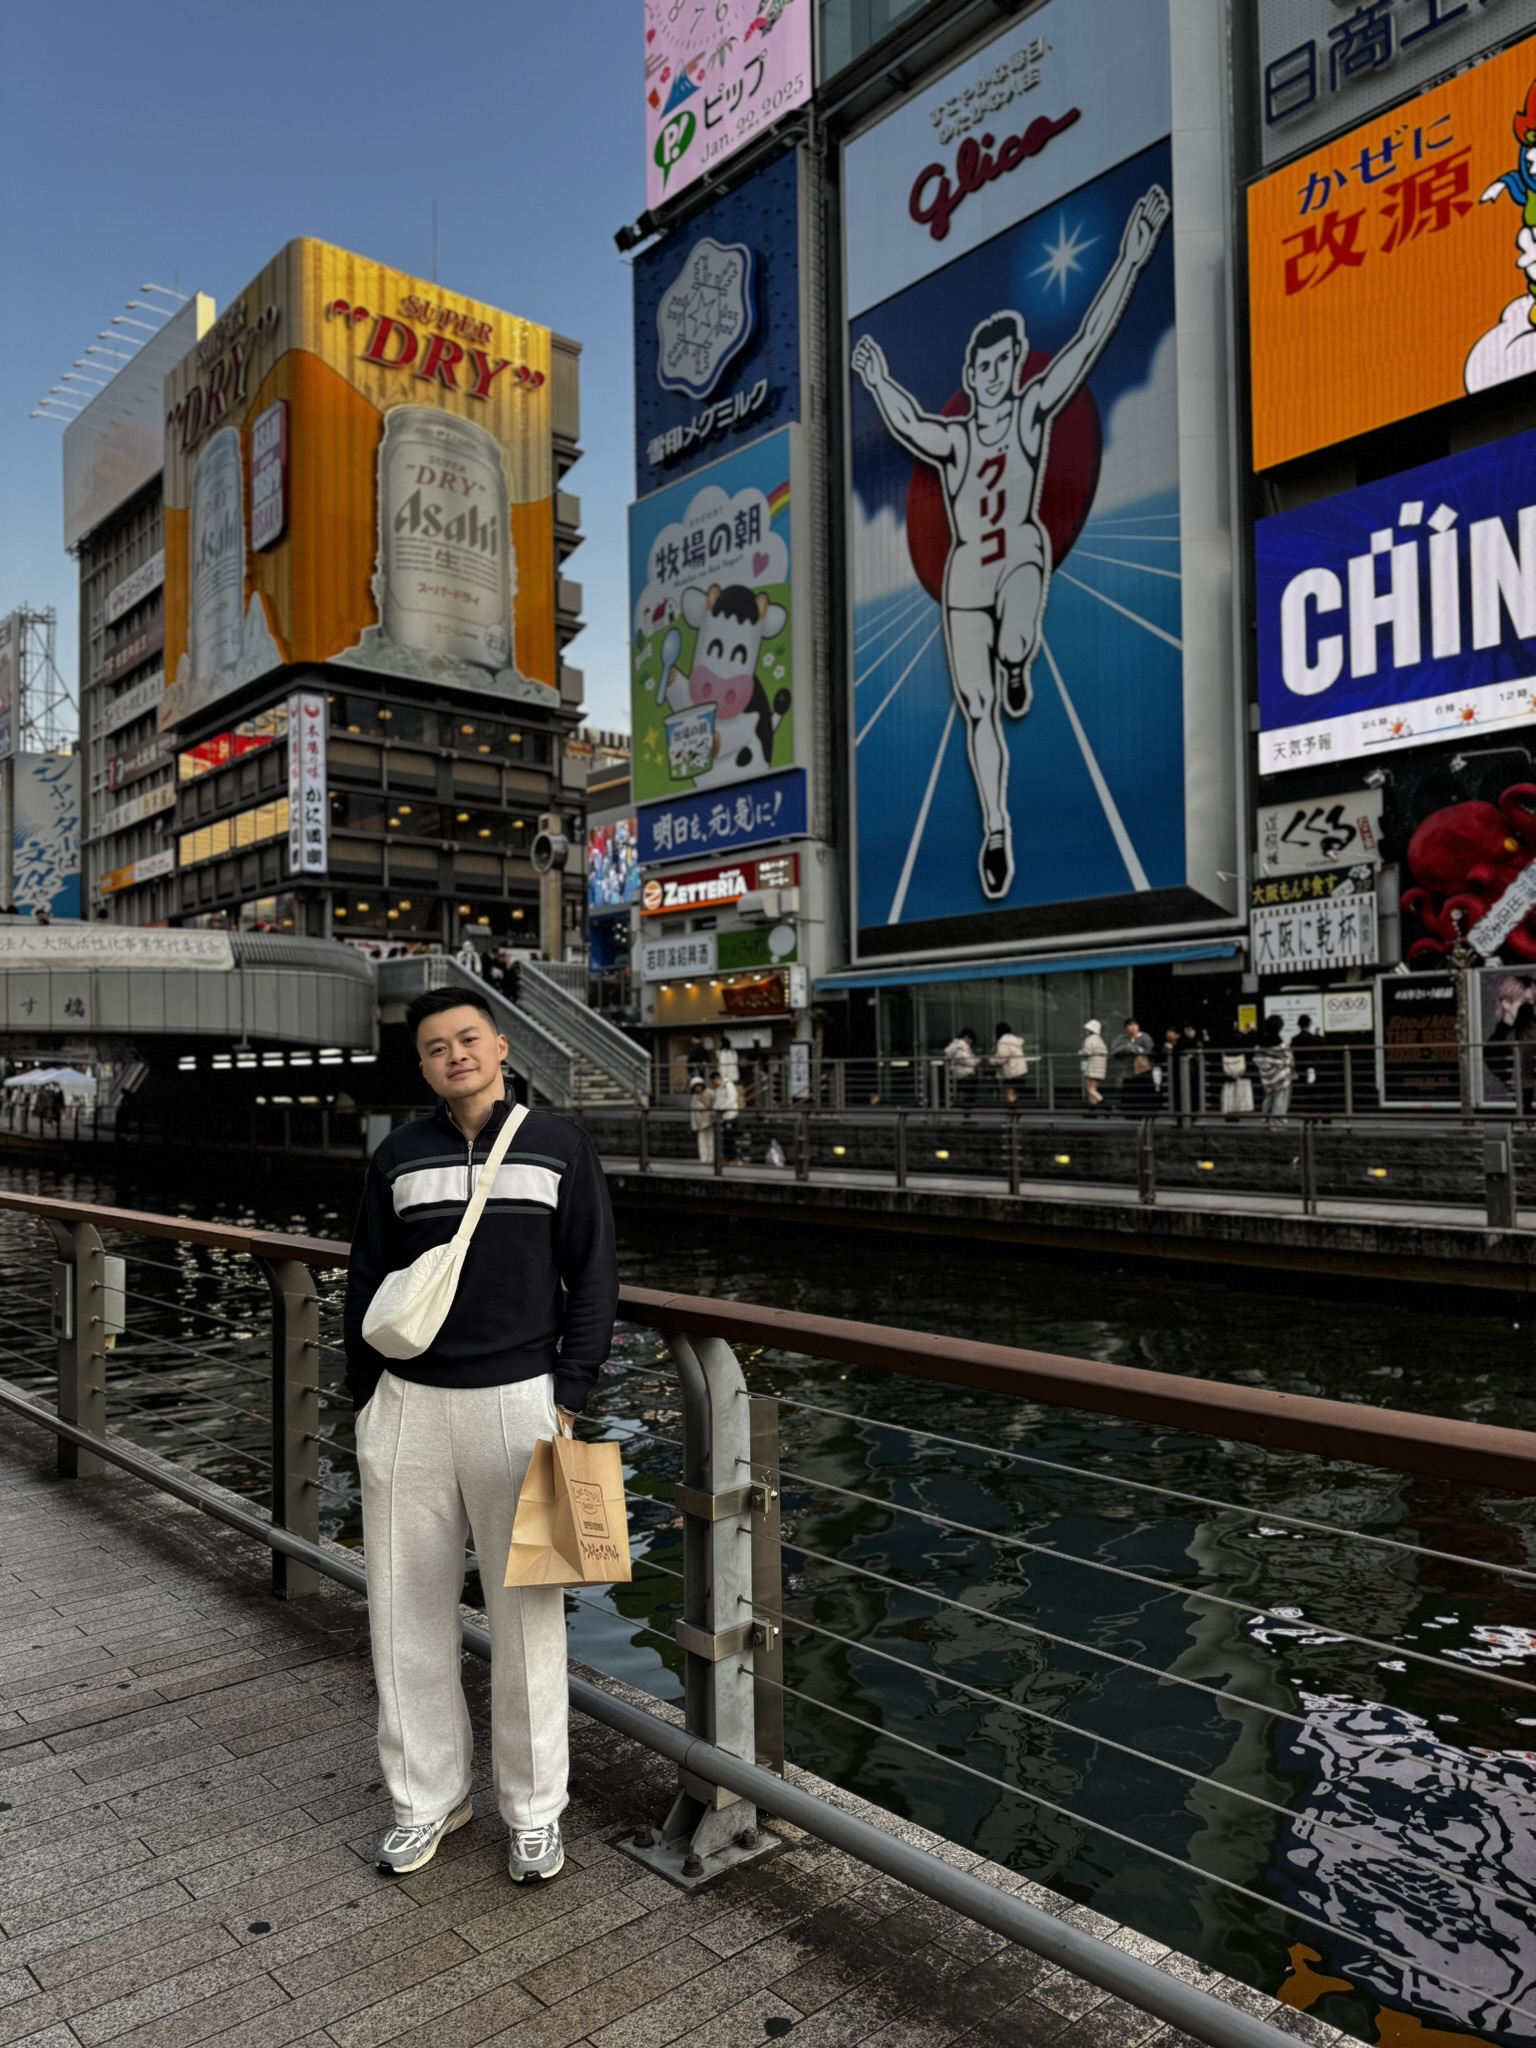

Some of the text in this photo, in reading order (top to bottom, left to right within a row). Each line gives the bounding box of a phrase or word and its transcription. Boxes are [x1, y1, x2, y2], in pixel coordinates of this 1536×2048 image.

[701, 72, 804, 163] Jan. 22, 2025
[704, 49, 767, 130] ピップ
[1297, 113, 1454, 215] かぜに
[1281, 144, 1474, 297] 改源
[401, 294, 494, 344] SUPER
[394, 488, 498, 558] Asahi
[976, 443, 1010, 567] グリコ
[434, 549, 462, 570] 生
[655, 502, 762, 585] 牧場の朝
[1272, 731, 1333, 762] 天気予報
[663, 875, 749, 907] ZETTERIA
[1258, 909, 1358, 962] 大阪に乾杯
